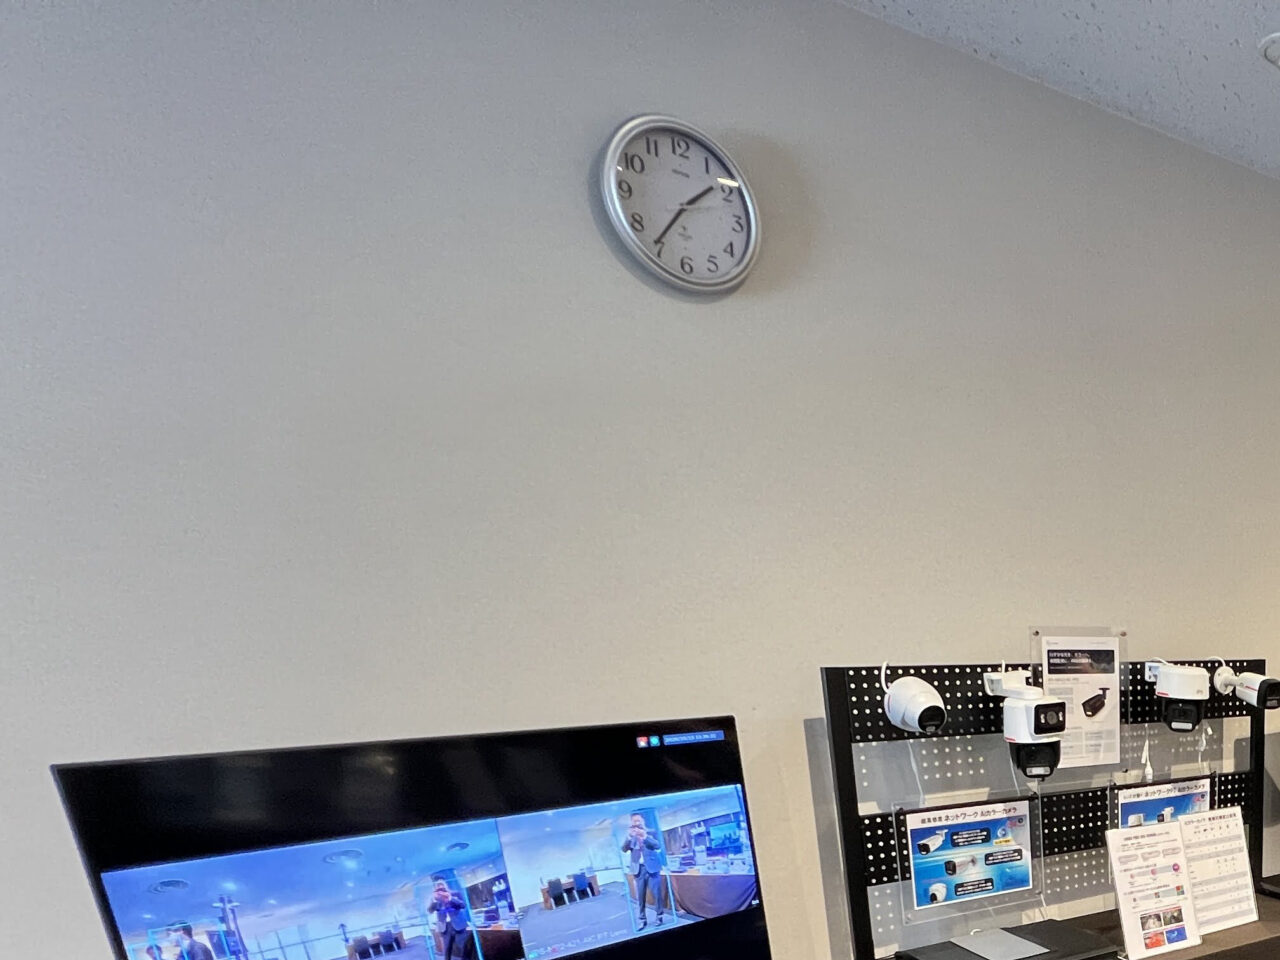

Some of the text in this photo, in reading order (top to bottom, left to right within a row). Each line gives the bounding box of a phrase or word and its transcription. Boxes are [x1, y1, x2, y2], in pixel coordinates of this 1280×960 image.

[645, 136, 659, 158] 11
[671, 136, 691, 160] 12
[624, 152, 645, 174] 10
[704, 156, 710, 175] 1
[617, 179, 633, 200] 9
[720, 185, 733, 204] 2
[630, 212, 645, 233] 8
[732, 214, 744, 233] 3
[655, 240, 665, 259] 7
[723, 241, 735, 258] 4
[680, 256, 694, 275] 6
[706, 254, 719, 274] 5
[944, 812, 979, 823] ネットワーク
